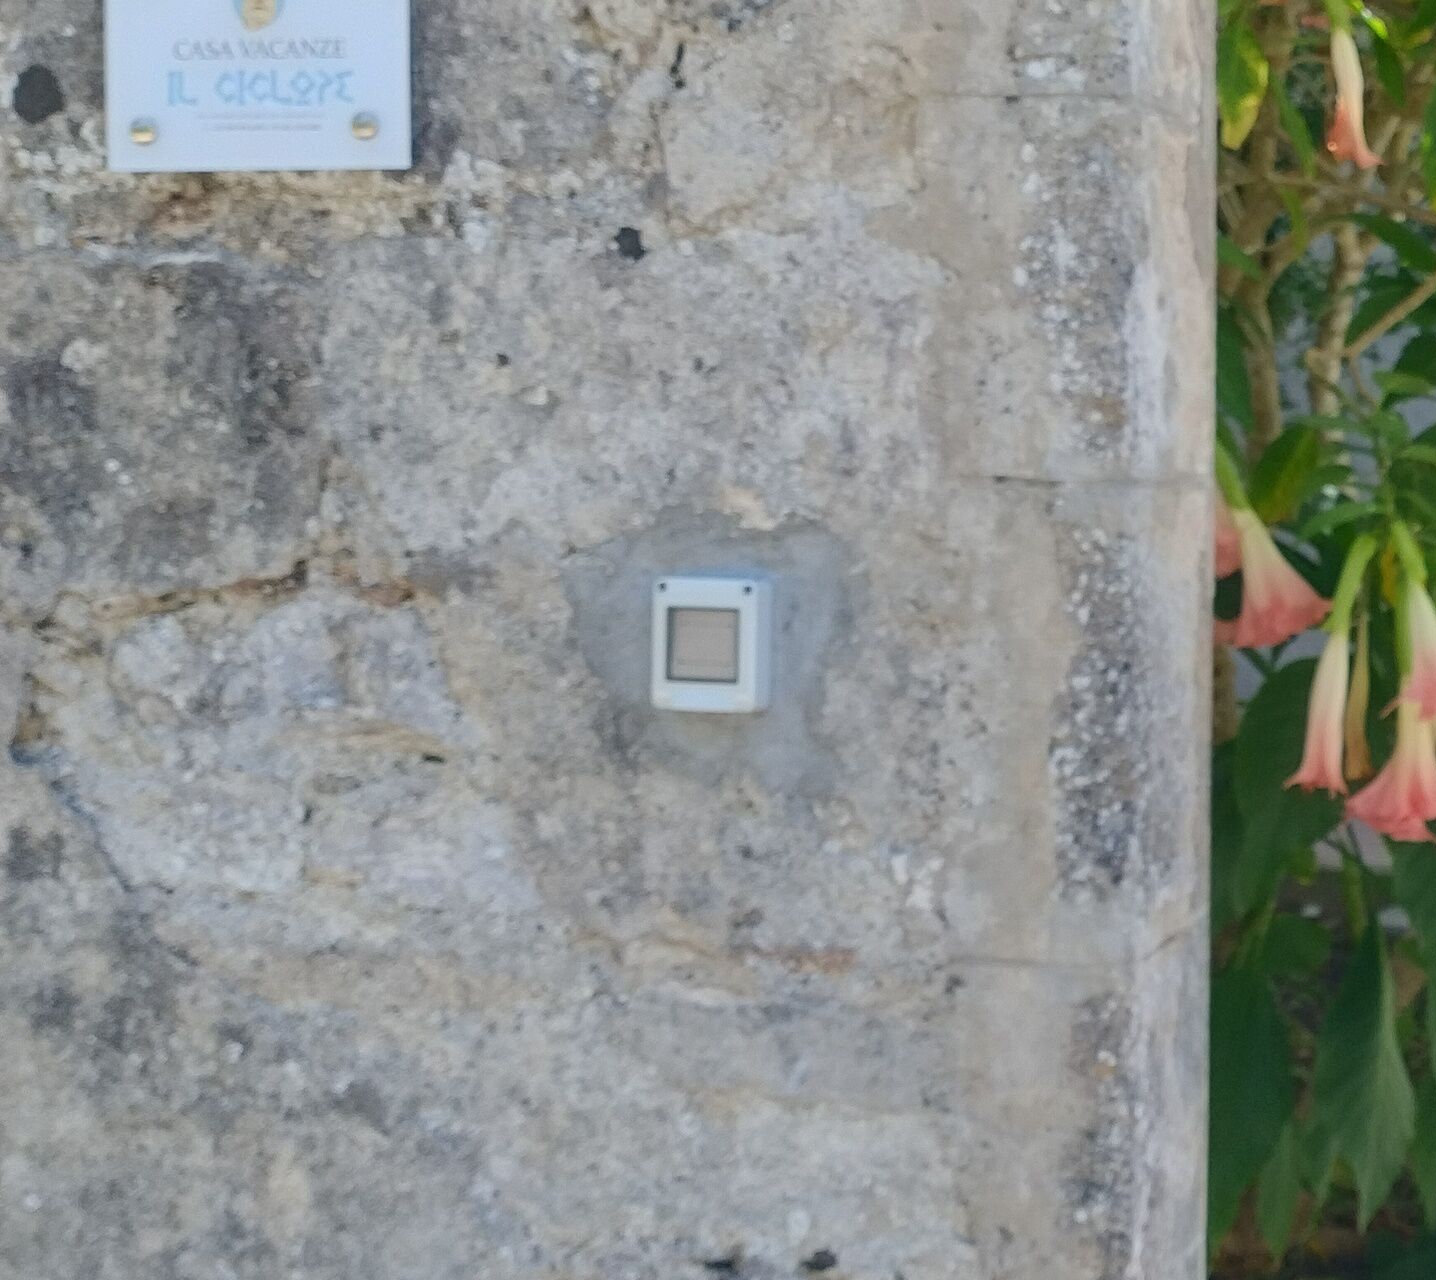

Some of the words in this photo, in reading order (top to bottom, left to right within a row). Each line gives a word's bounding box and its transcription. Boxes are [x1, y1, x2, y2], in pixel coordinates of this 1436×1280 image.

[172, 38, 234, 61] CASA
[236, 37, 346, 60] VACANZE
[166, 70, 198, 106] IL
[214, 70, 355, 106] CICLOPE
